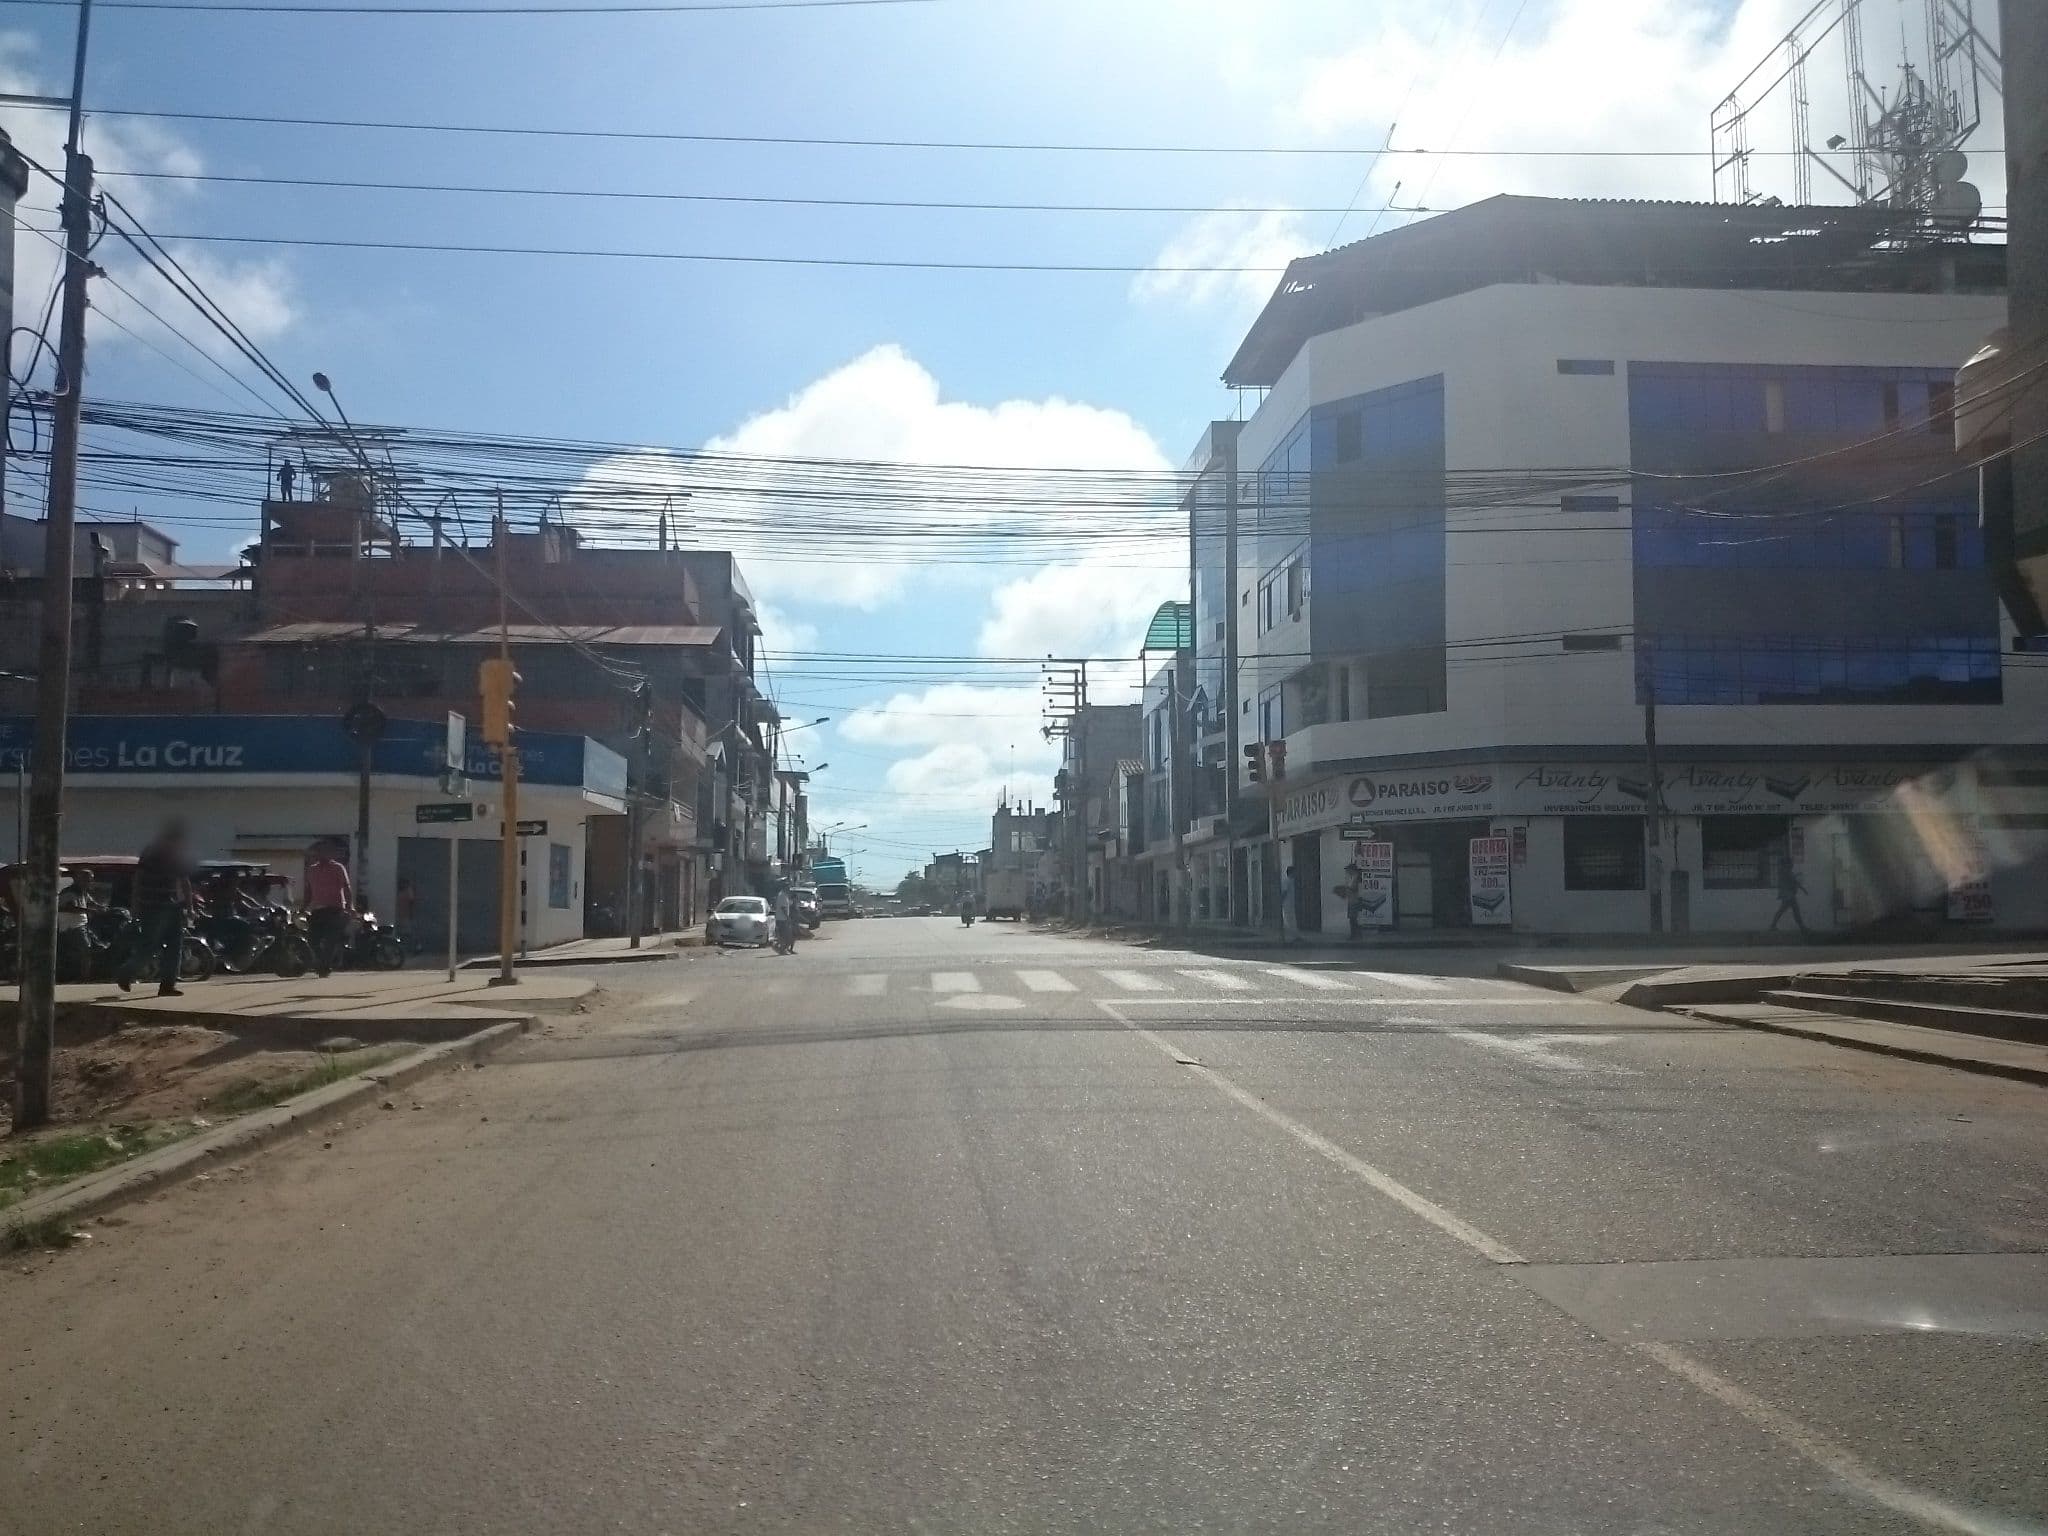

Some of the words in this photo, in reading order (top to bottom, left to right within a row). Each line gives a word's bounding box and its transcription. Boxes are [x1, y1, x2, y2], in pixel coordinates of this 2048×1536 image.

[118, 741, 156, 767] La
[164, 741, 243, 767] Cruz
[1378, 781, 1449, 799] PARAISO
[1514, 765, 1610, 804] Avanty
[1666, 765, 1760, 804] Avanty
[1280, 791, 1326, 824] PARAISO
